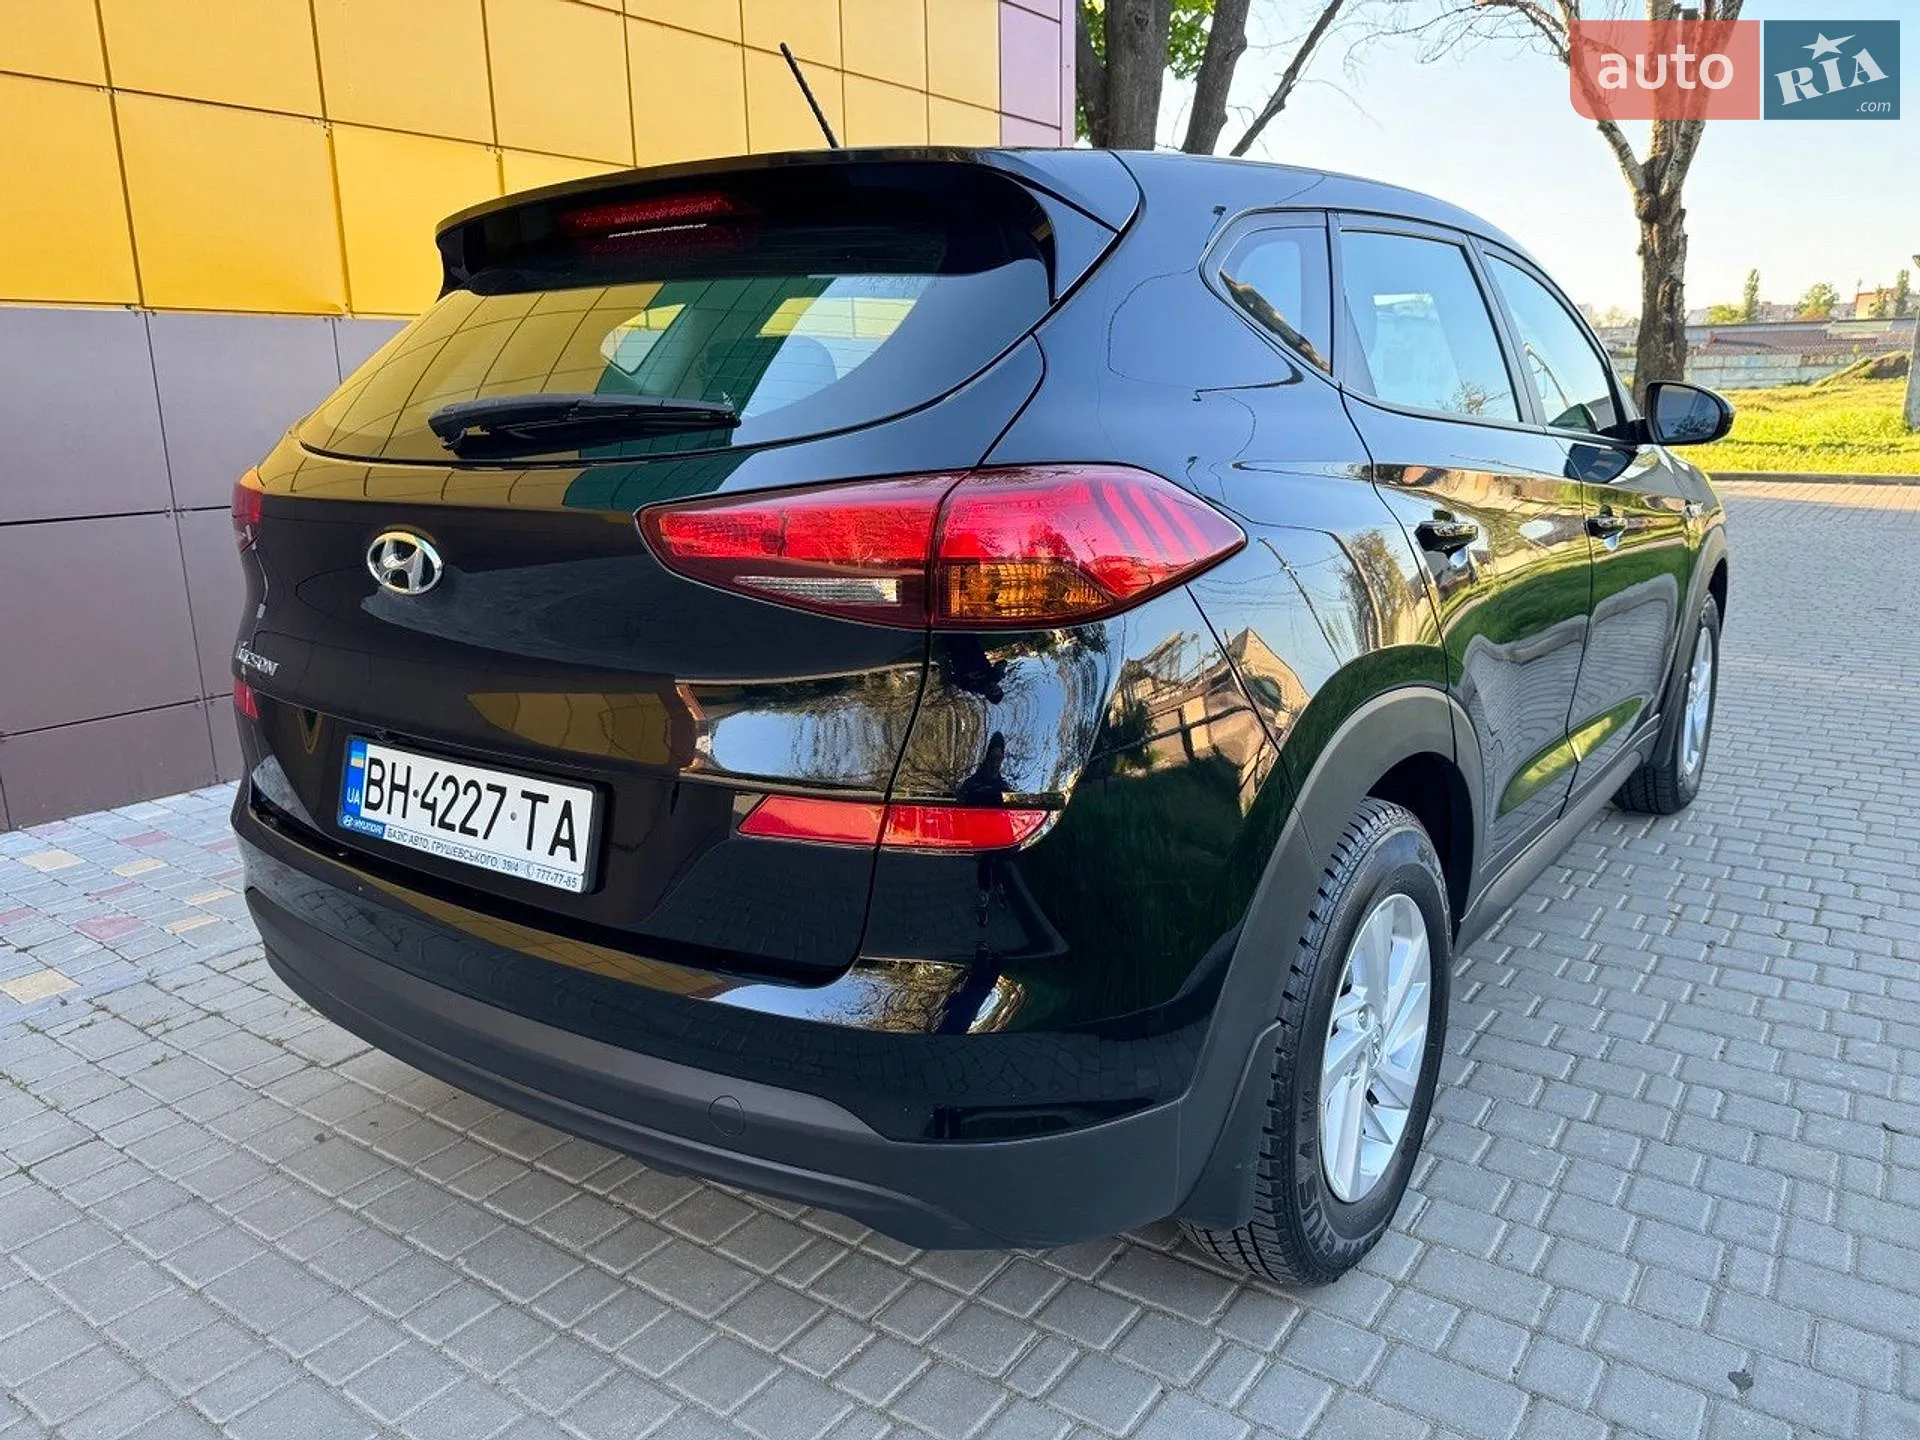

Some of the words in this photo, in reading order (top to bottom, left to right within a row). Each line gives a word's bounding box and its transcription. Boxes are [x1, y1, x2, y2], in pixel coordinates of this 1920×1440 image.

[347, 786, 361, 806] UA
[420, 771, 507, 840] 4227
[521, 790, 578, 862] TA
